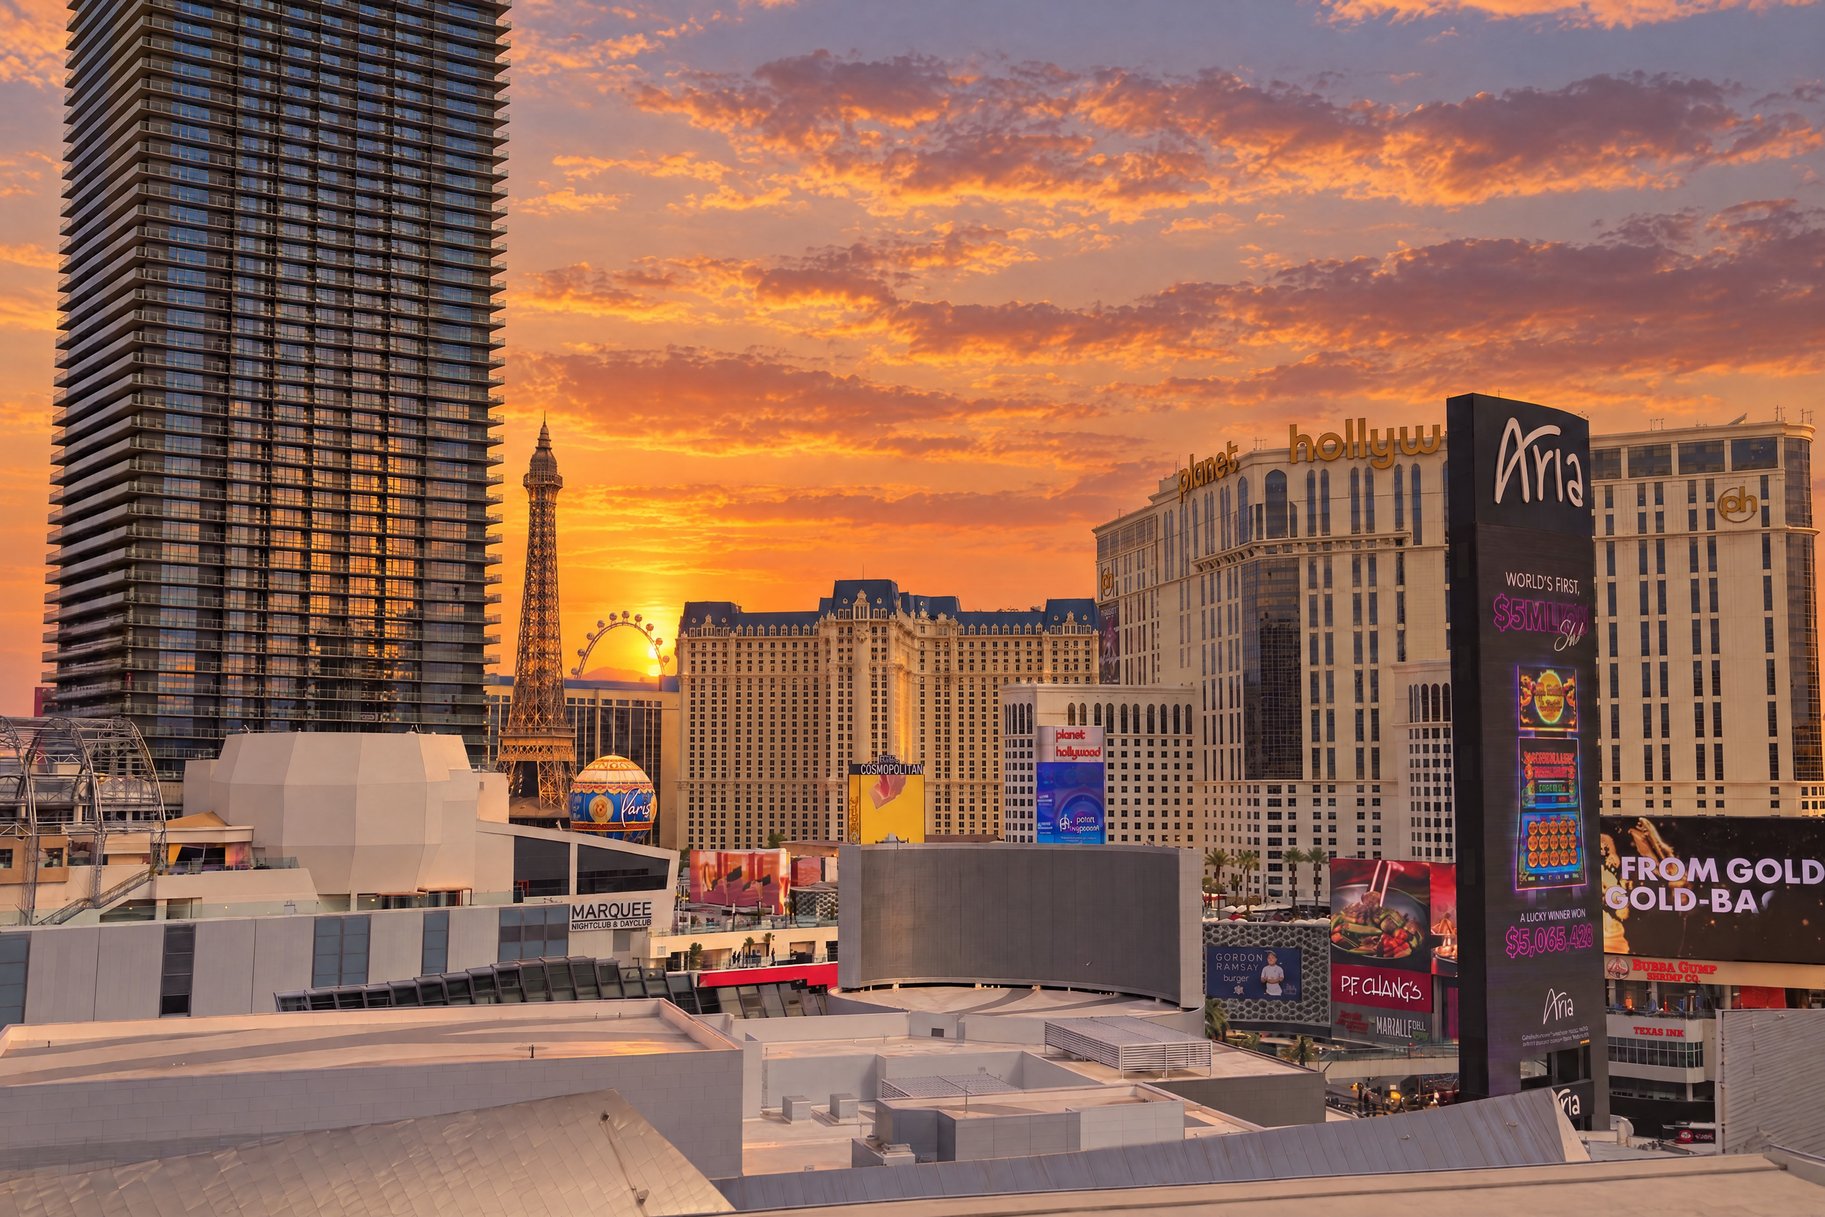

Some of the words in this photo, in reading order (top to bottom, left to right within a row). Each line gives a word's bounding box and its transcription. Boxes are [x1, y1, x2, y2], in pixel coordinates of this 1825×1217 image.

[1178, 441, 1239, 504] planet
[1289, 418, 1441, 470] hollyw
[1494, 417, 1583, 507] Aria
[1505, 571, 1553, 592] WORLD'S
[1555, 577, 1580, 596] FIRST,
[1055, 728, 1086, 743] planet
[1055, 745, 1102, 760] hollywood
[860, 763, 924, 775] COSMOPOLITAN
[621, 788, 652, 828] Paris
[1621, 856, 1719, 883] FROM
[1726, 857, 1825, 885] GOLD
[571, 902, 652, 919] MARQUEE
[1520, 913, 1526, 922] A
[1526, 911, 1547, 922] LUCKY
[1547, 909, 1571, 920] WINNER
[1571, 908, 1586, 918] WON
[571, 921, 612, 930] NIGHTCLUB
[620, 919, 652, 928] DAYCLUB
[1215, 953, 1263, 962] GORDON
[1216, 963, 1259, 971] RAMSAY
[1632, 958, 1676, 973] BUBBA
[1678, 961, 1718, 975] GUMP
[1223, 974, 1249, 984] burger
[1647, 973, 1683, 982] SHRIMP
[1341, 975, 1360, 996] P.F.
[1542, 987, 1574, 1025] Aria
[1633, 1026, 1664, 1037] TEXAS
[1665, 1029, 1684, 1038] INK
